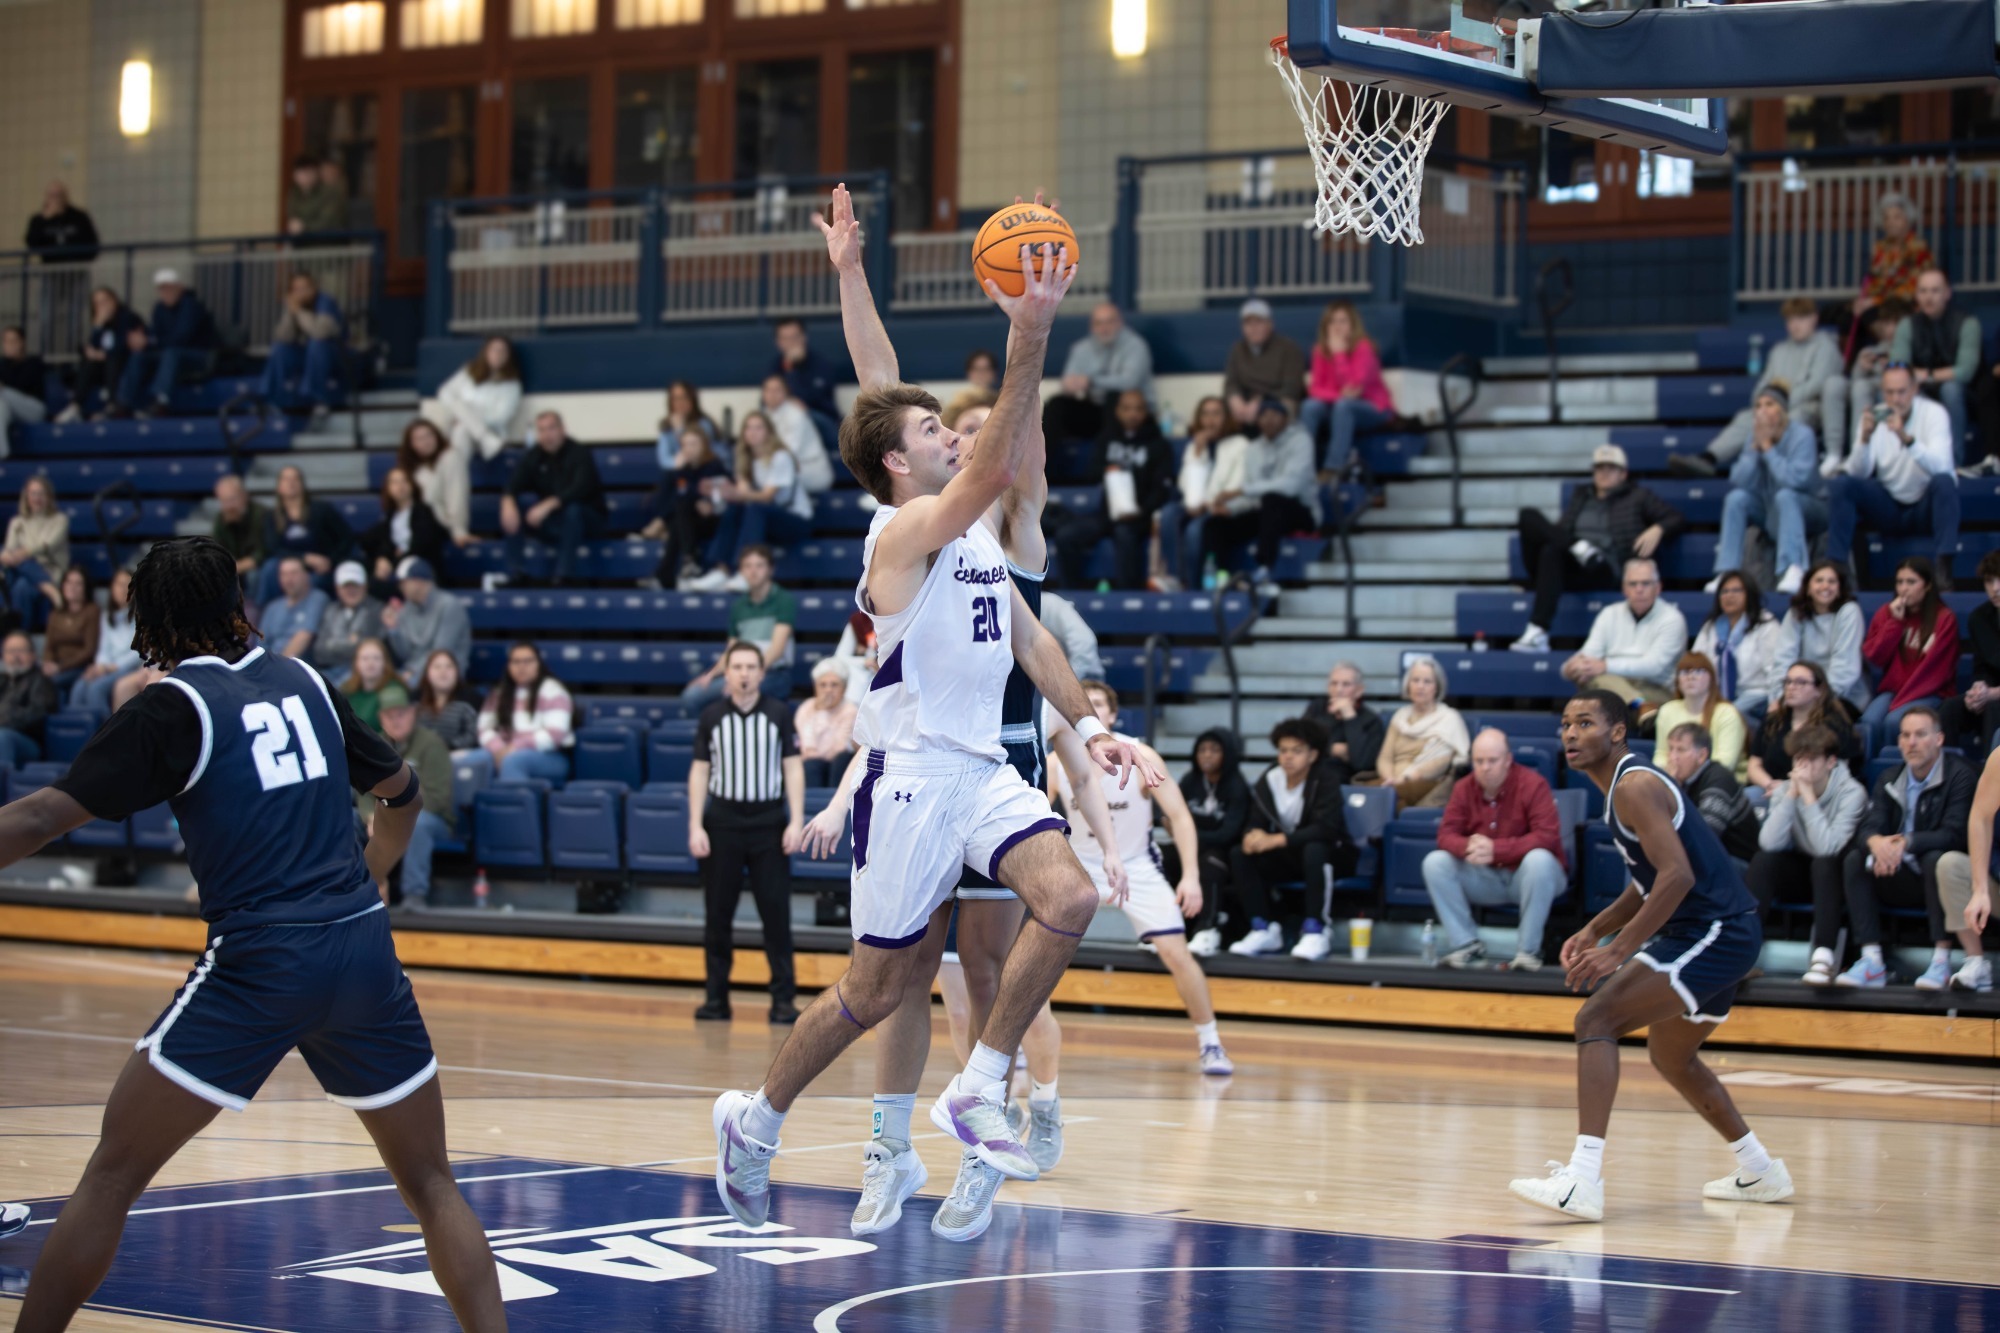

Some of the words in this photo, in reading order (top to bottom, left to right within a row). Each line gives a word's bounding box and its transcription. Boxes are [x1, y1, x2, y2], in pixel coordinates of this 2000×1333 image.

[998, 210, 1067, 231] Wilson
[972, 596, 1003, 642] 20
[241, 694, 329, 791] 21
